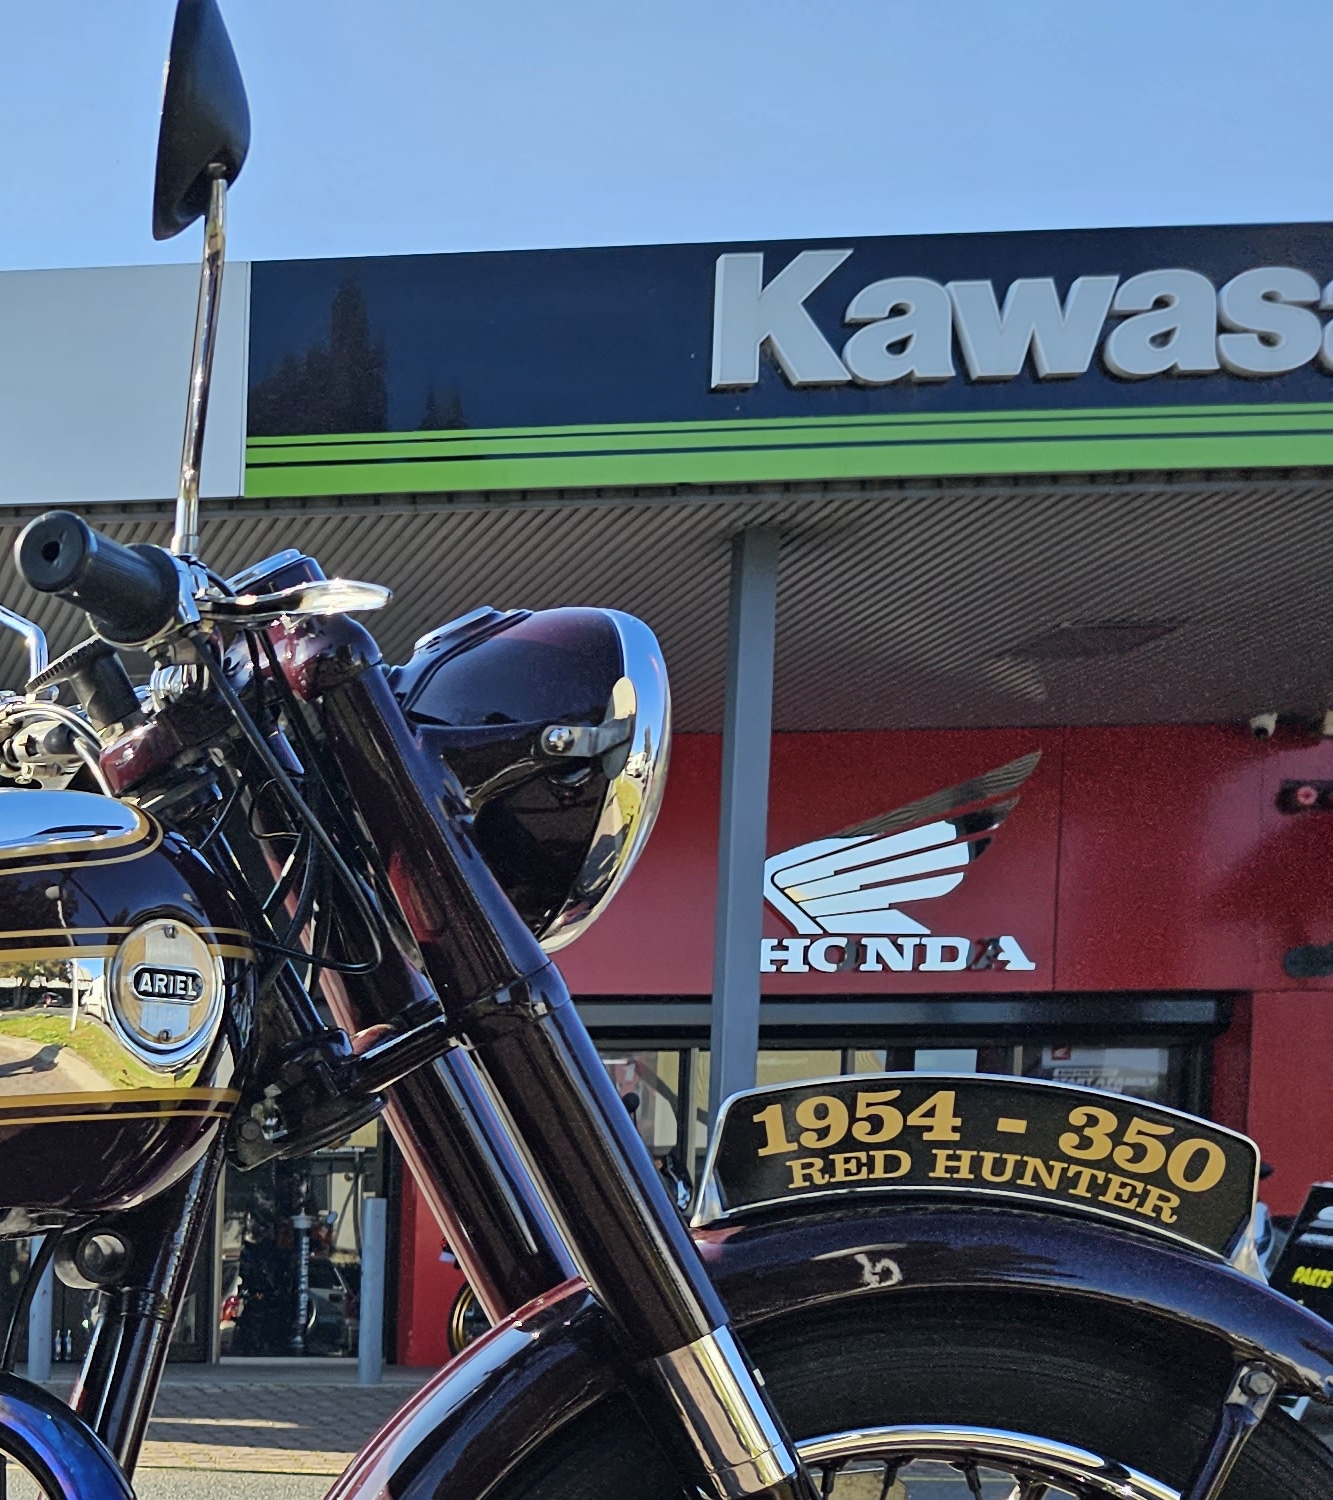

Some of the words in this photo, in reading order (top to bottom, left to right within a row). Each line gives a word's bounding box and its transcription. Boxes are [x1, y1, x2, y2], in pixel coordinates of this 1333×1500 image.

[710, 248, 1333, 390] Kawas
[138, 972, 197, 996] ARIEL
[760, 935, 1036, 973] HONDA
[752, 1090, 963, 1158] 1954
[1058, 1105, 1227, 1194] 350
[787, 1150, 912, 1190] RED
[928, 1148, 1181, 1225] HUNTER
